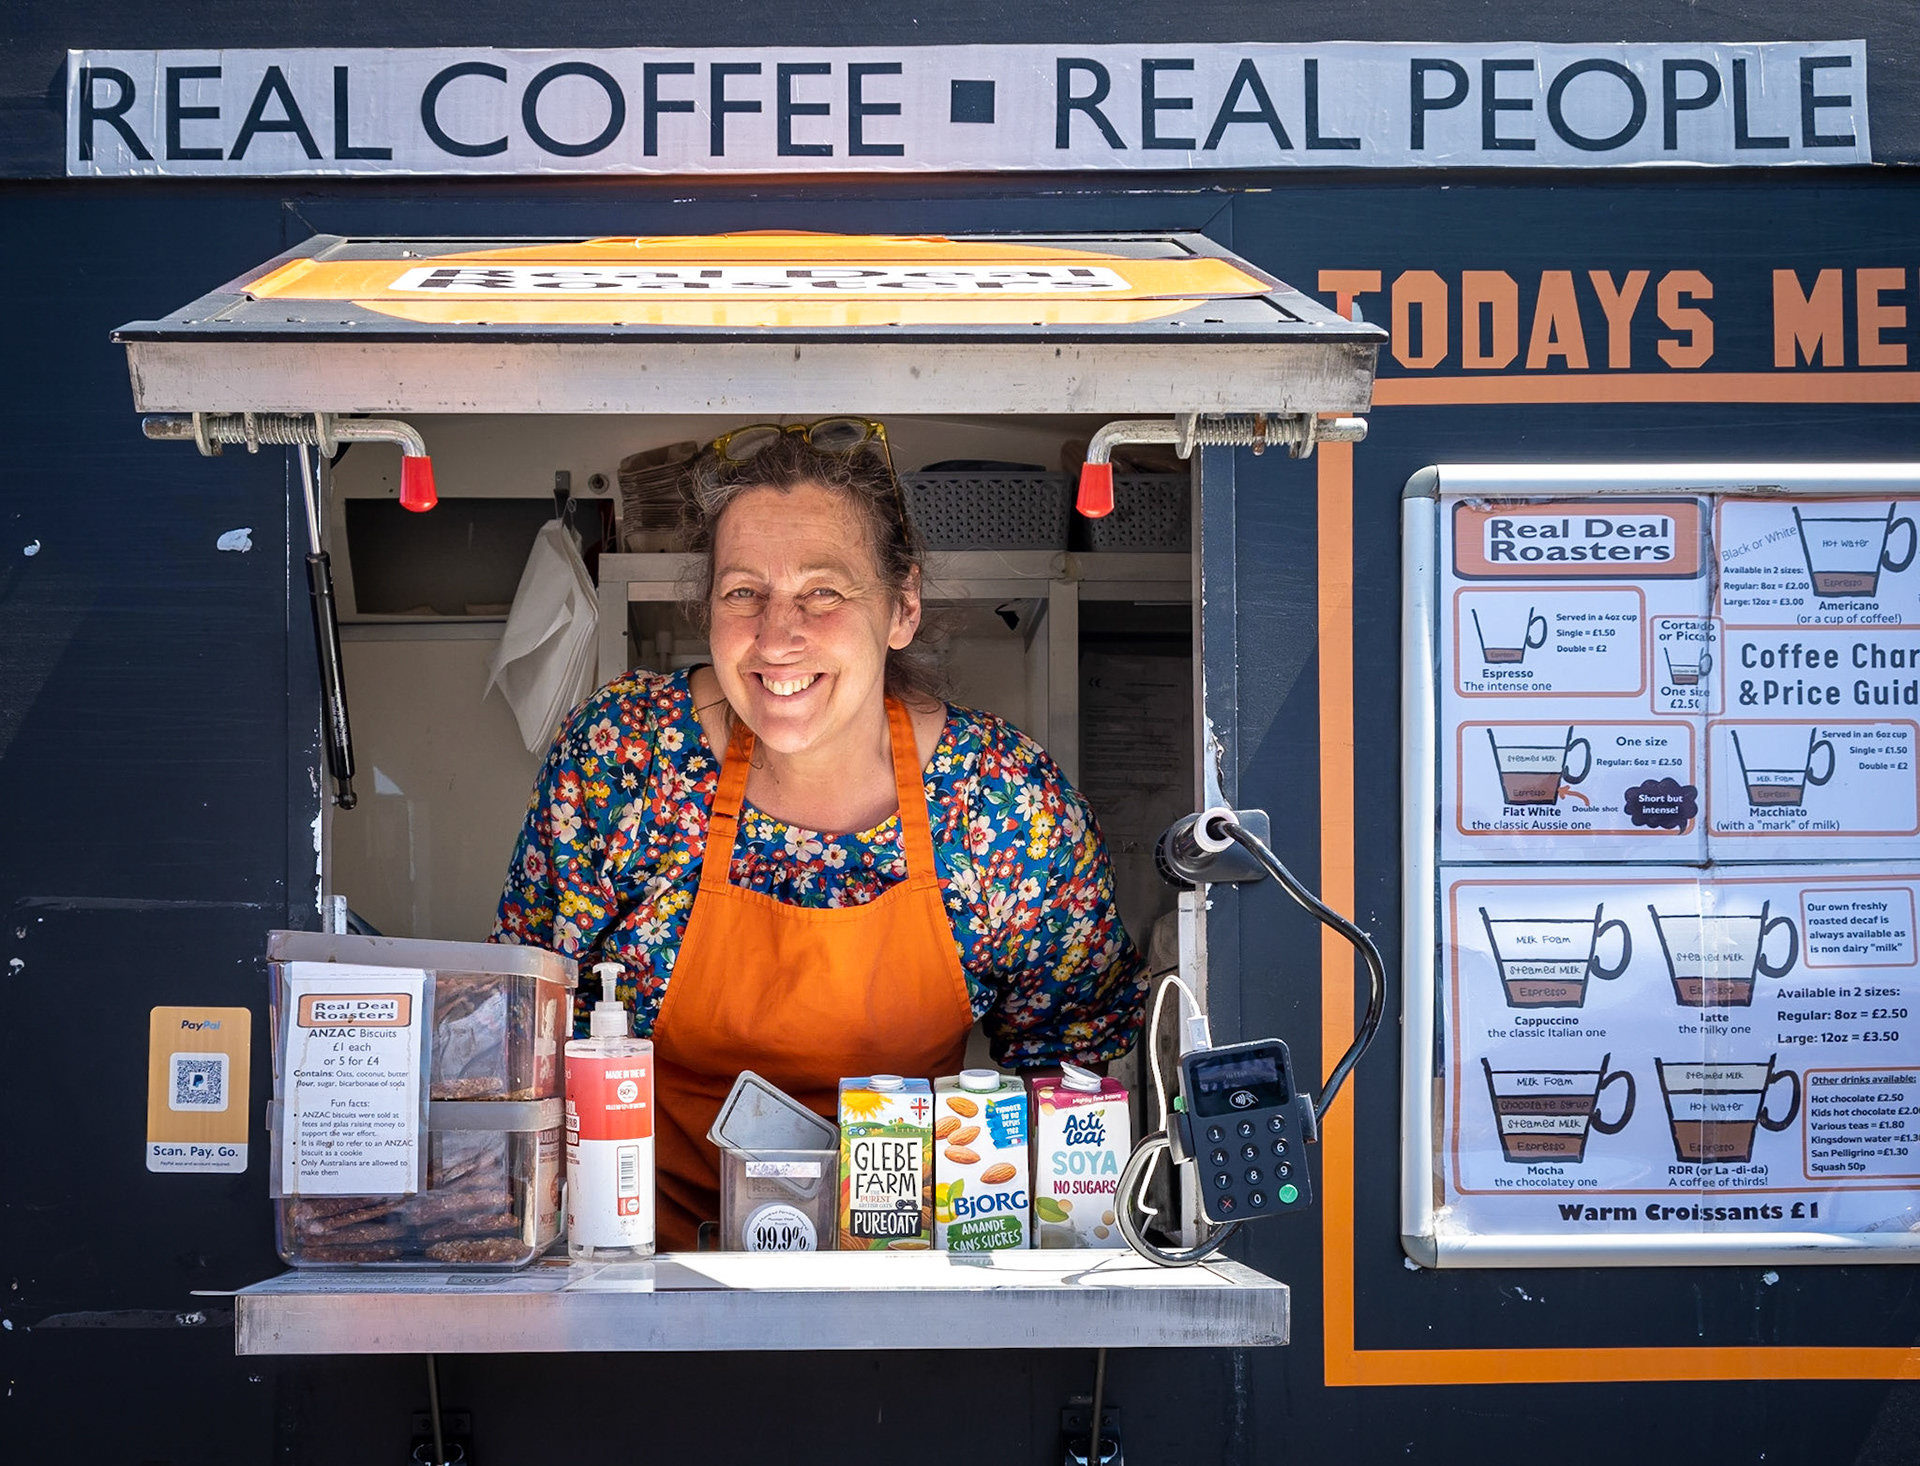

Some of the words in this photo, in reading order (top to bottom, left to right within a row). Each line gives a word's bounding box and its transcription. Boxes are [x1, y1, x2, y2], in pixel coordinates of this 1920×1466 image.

[79, 64, 393, 161] REAL
[420, 60, 905, 158] COFFEE
[1055, 57, 1360, 151] REAL
[1411, 55, 1857, 152] PEOPLE
[433, 268, 723, 279] Real
[786, 268, 1095, 279] Deal
[418, 278, 1131, 289] Roasters
[1318, 268, 1714, 369] TODAYS
[1491, 518, 1569, 539] Real
[1585, 518, 1668, 539] Deal
[1722, 545, 1751, 561] Black
[1752, 537, 1764, 550] or
[1765, 525, 1797, 544] White
[1491, 540, 1670, 561] Roasters
[1819, 601, 1879, 610] Americano
[1796, 614, 1813, 625] (or
[1824, 616, 1844, 625] cup
[1847, 614, 1858, 623] of
[1860, 614, 1902, 625] coffee!)
[1741, 643, 1839, 669] Coffee
[1482, 669, 1534, 680] Espresso
[1464, 682, 1484, 691] The
[1487, 682, 1530, 691] intense
[1532, 683, 1552, 691] one
[1739, 679, 1840, 705] &Price
[1616, 736, 1642, 747] One
[1645, 736, 1668, 747] size
[1639, 795, 1664, 803] Short
[1667, 795, 1683, 803] but
[1503, 807, 1525, 816] Flat
[1527, 807, 1561, 816] White
[1642, 806, 1679, 814] intense!
[1750, 808, 1807, 817] Macchiato
[1472, 820, 1491, 830] the
[1494, 820, 1529, 830] classic
[1532, 820, 1568, 830] Aussie
[1571, 822, 1591, 830] one
[1716, 821, 1747, 831] (with
[1757, 821, 1796, 830] "mark"
[1798, 821, 1810, 830] of
[1812, 821, 1840, 831] milk)
[1807, 903, 1826, 911] Our
[1852, 902, 1887, 912] freshly
[1809, 917, 1848, 925] roasted
[1850, 916, 1877, 925] decaf
[1880, 916, 1889, 924] is
[1516, 936, 1538, 944] Milk
[1542, 936, 1571, 944] Foam
[1810, 931, 1844, 940] always
[1846, 930, 1891, 938] available
[1810, 945, 1819, 953] is
[1843, 944, 1868, 954] dairy
[1870, 943, 1903, 952] "milk"
[1510, 965, 1555, 974] Steamed
[1559, 965, 1581, 974] Milk
[1519, 987, 1567, 997] Espresso
[1777, 988, 1836, 998] Available
[1839, 988, 1851, 997] in
[1853, 987, 1862, 997] 2
[1864, 987, 1901, 997] sizes:
[315, 1002, 350, 1010] Real
[357, 1002, 394, 1010] Deal
[315, 1011, 394, 1019] Roasters
[1778, 1011, 1831, 1023] Regular:
[1834, 1010, 1857, 1020] 8oz
[1872, 1009, 1908, 1019] £2.50
[181, 1020, 220, 1031] PayPal
[1514, 1016, 1579, 1027] Cappuccino
[309, 1029, 356, 1038] ANZAC
[360, 1029, 397, 1038] Biscuits
[1488, 1029, 1506, 1037] the
[1509, 1029, 1545, 1037] classic
[1548, 1029, 1583, 1037] Italian
[1778, 1034, 1818, 1045] Large:
[1821, 1033, 1848, 1043] 12oz
[1862, 1032, 1899, 1042] £3.50
[333, 1042, 344, 1051] £1
[348, 1042, 371, 1051] each
[339, 1056, 345, 1065] 5
[348, 1056, 361, 1065] for
[367, 1056, 379, 1065] £4
[1812, 1076, 1838, 1085] Other
[1840, 1076, 1870, 1084] drinks
[1872, 1074, 1917, 1084] available:
[1811, 1095, 1828, 1103] Hot
[1830, 1094, 1875, 1103] chocolate
[1877, 1093, 1904, 1102] £2.50
[1063, 1112, 1103, 1134] Acti
[1213, 1130, 1219, 1139] 1
[1243, 1125, 1250, 1134] 2
[1274, 1120, 1280, 1129] 3
[153, 1146, 186, 1156] Scan.
[190, 1146, 214, 1159] Pay.
[218, 1146, 239, 1157] Go.
[854, 1142, 918, 1172] GLEBE
[1216, 1153, 1223, 1162] 4
[1247, 1148, 1253, 1157] 5
[1277, 1143, 1284, 1152] 6
[1052, 1151, 1118, 1175] SOYA
[1811, 1163, 1846, 1173] Squash
[1847, 1162, 1866, 1171] 50p
[1220, 1176, 1227, 1185] 7
[1251, 1171, 1257, 1180] 8
[1280, 1166, 1287, 1176] 9
[1527, 1166, 1564, 1175] Mocha
[1668, 1165, 1693, 1175] RDR
[1696, 1165, 1713, 1176] (or
[1715, 1165, 1728, 1175] La
[1731, 1165, 1768, 1176] -di-da)
[856, 1173, 916, 1199] FARM
[1053, 1181, 1070, 1194] NO
[1072, 1180, 1117, 1193] SUGARS
[1494, 1178, 1513, 1186] the
[1516, 1178, 1575, 1188] chocolatey
[1668, 1178, 1677, 1187] A
[1679, 1178, 1715, 1187] coffee
[1718, 1178, 1730, 1187] of
[1732, 1177, 1768, 1186] thirds!
[860, 1195, 890, 1203] PUREST
[1254, 1194, 1261, 1204] 0
[1558, 1203, 1637, 1221] Warm
[1645, 1203, 1783, 1221] Croissants
[855, 1211, 918, 1234] PUREOATY
[962, 1219, 1005, 1236] AMANDE
[757, 1226, 806, 1250] 99.9%
[953, 1234, 980, 1250] SANS
[981, 1232, 1021, 1248] SUCRES
